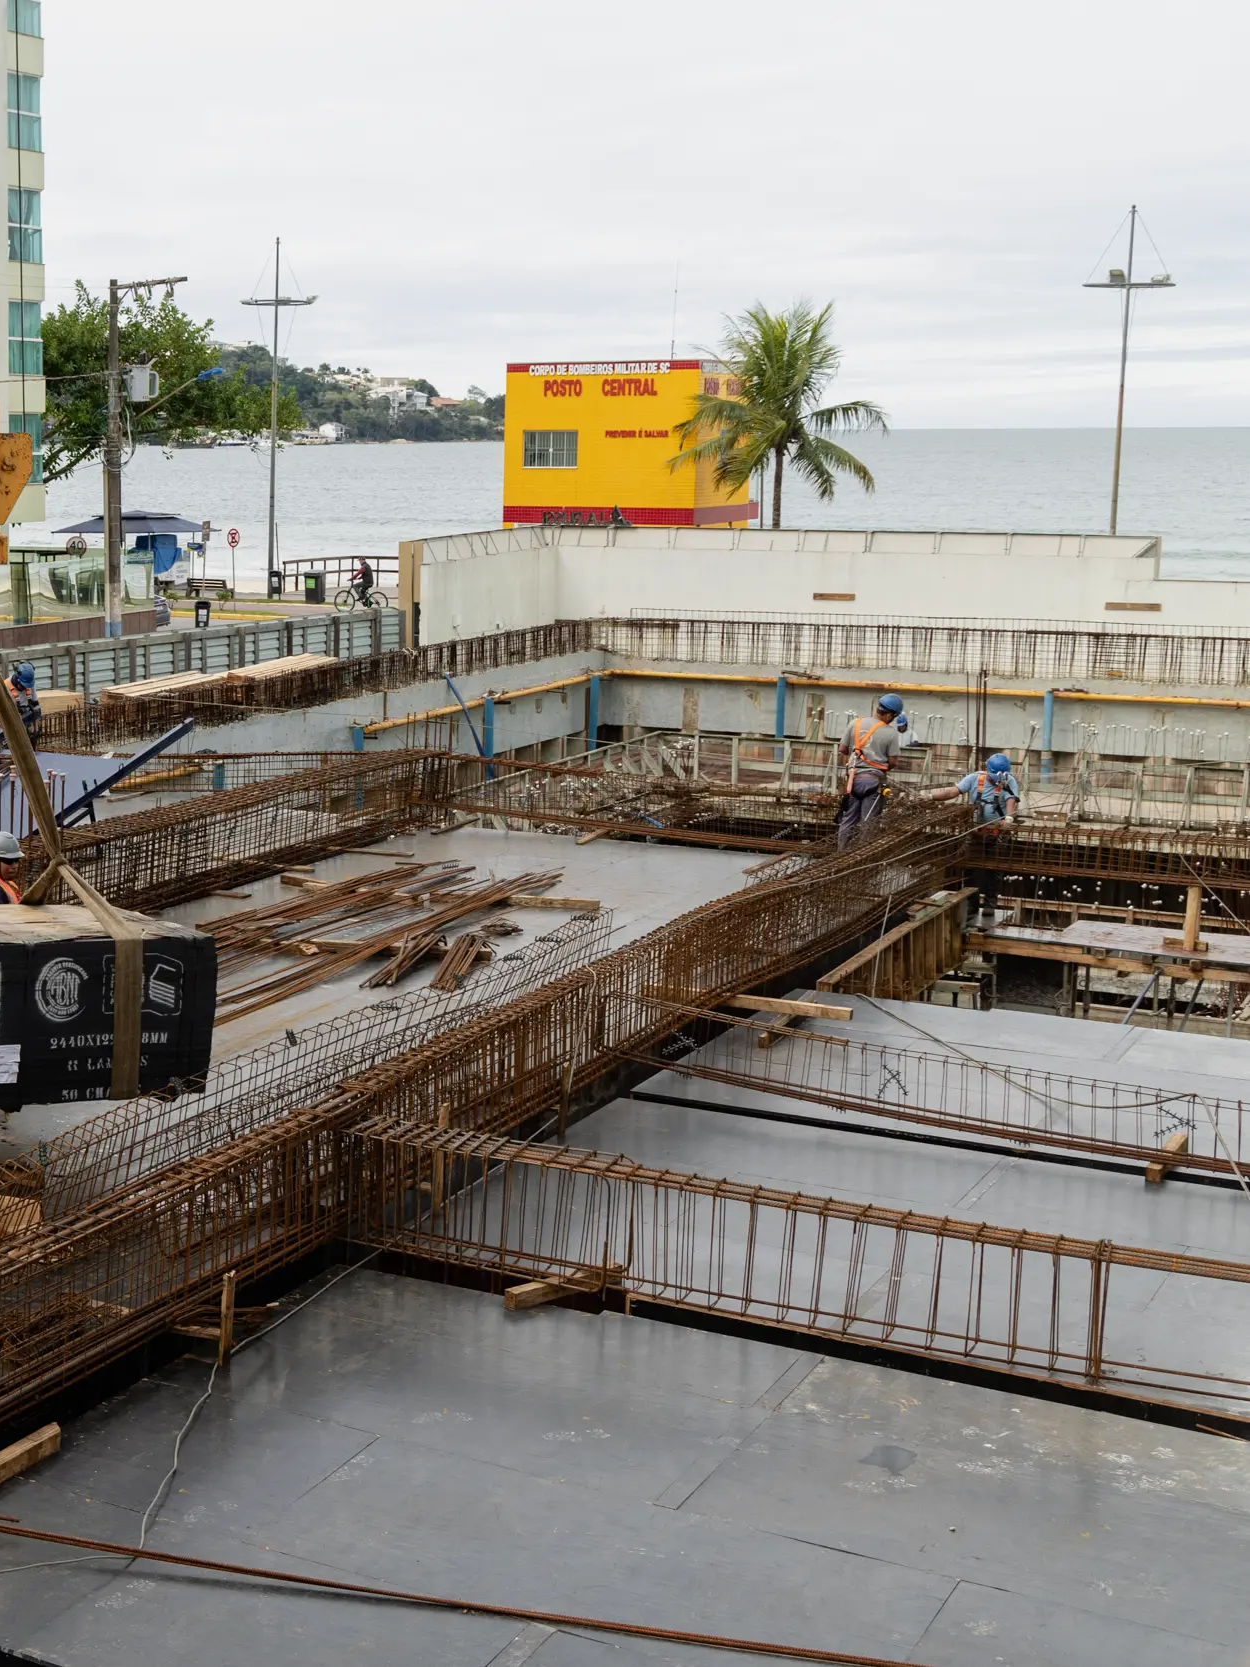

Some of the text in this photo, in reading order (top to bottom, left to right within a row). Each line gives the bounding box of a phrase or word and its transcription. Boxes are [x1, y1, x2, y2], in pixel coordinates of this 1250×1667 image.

[529, 361, 671, 376] CORPO DE BOMBEIROS MILITAR DE SC
[543, 378, 658, 397] POSTO CENTRAL
[644, 429, 669, 438] SALVAR
[69, 540, 83, 550] 40
[61, 1088, 78, 1100] 50
